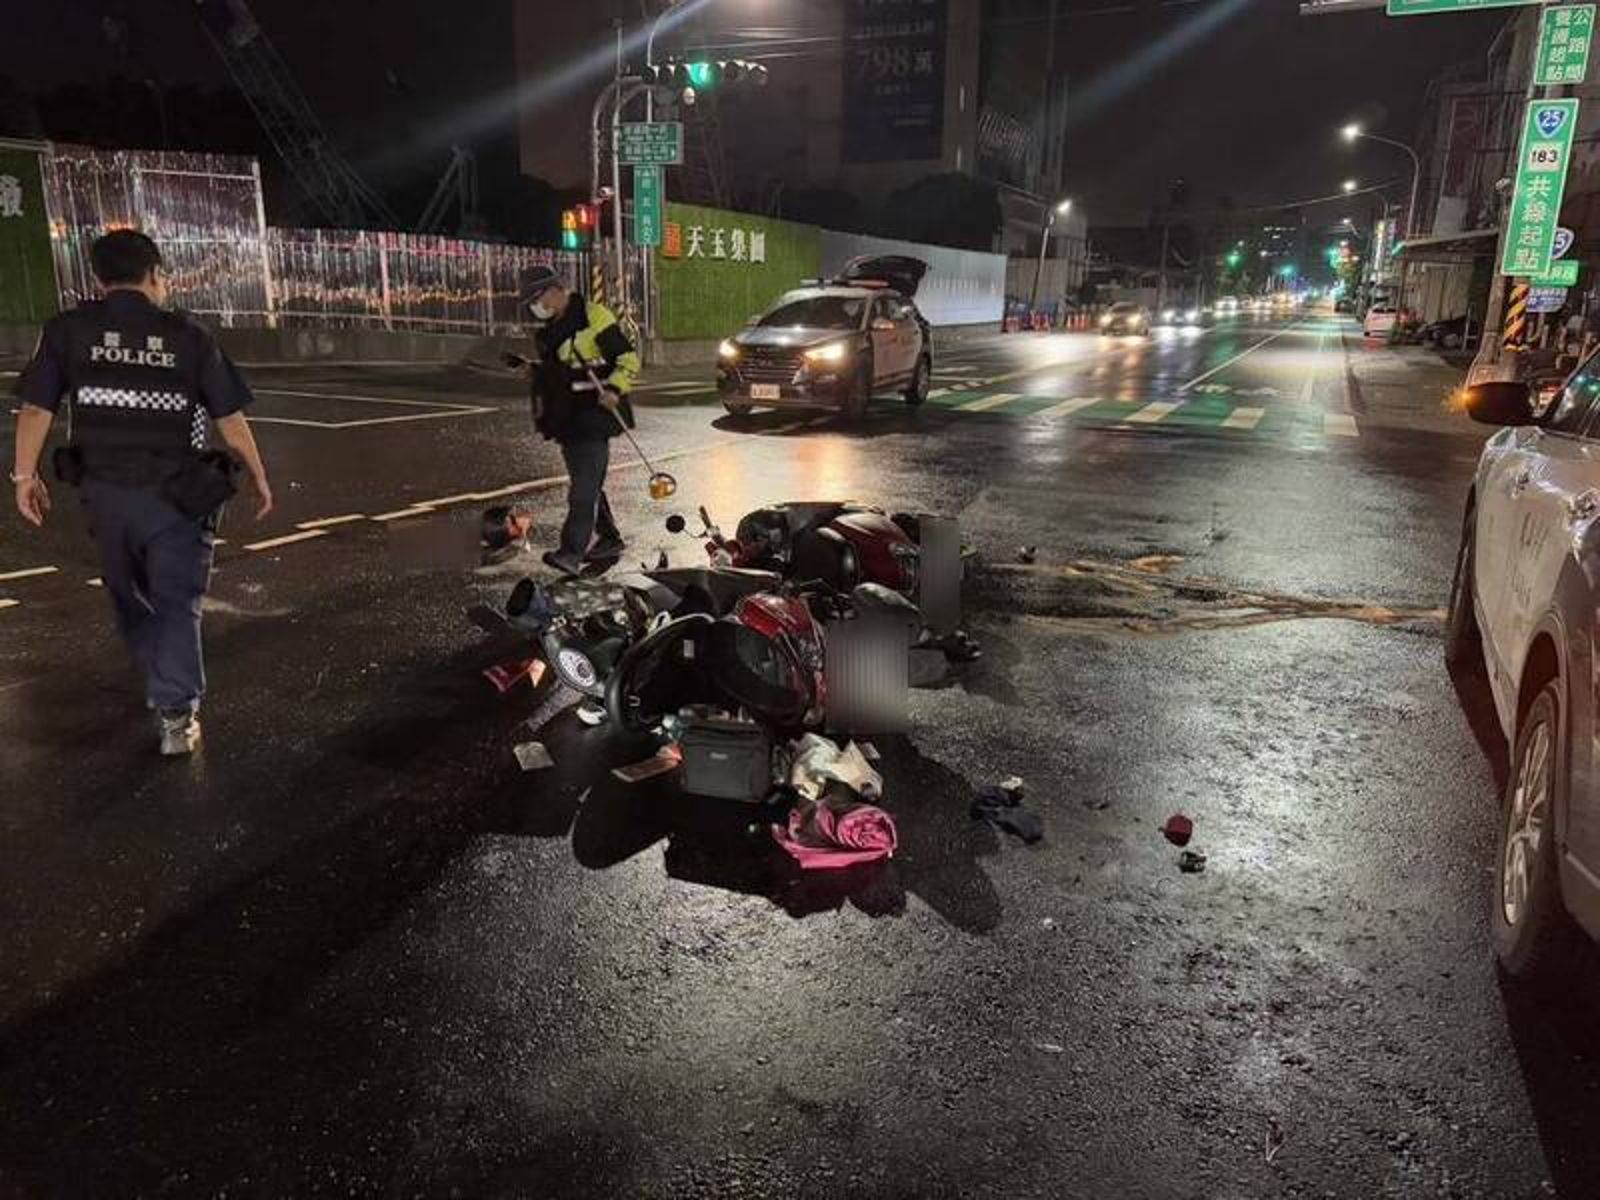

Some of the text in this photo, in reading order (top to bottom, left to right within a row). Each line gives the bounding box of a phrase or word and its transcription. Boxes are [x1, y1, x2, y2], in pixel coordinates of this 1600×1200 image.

[1541, 110, 1561, 127] 25
[1531, 150, 1558, 164] 183
[687, 225, 766, 263] 天玉集團
[91, 346, 176, 368] POLICE
